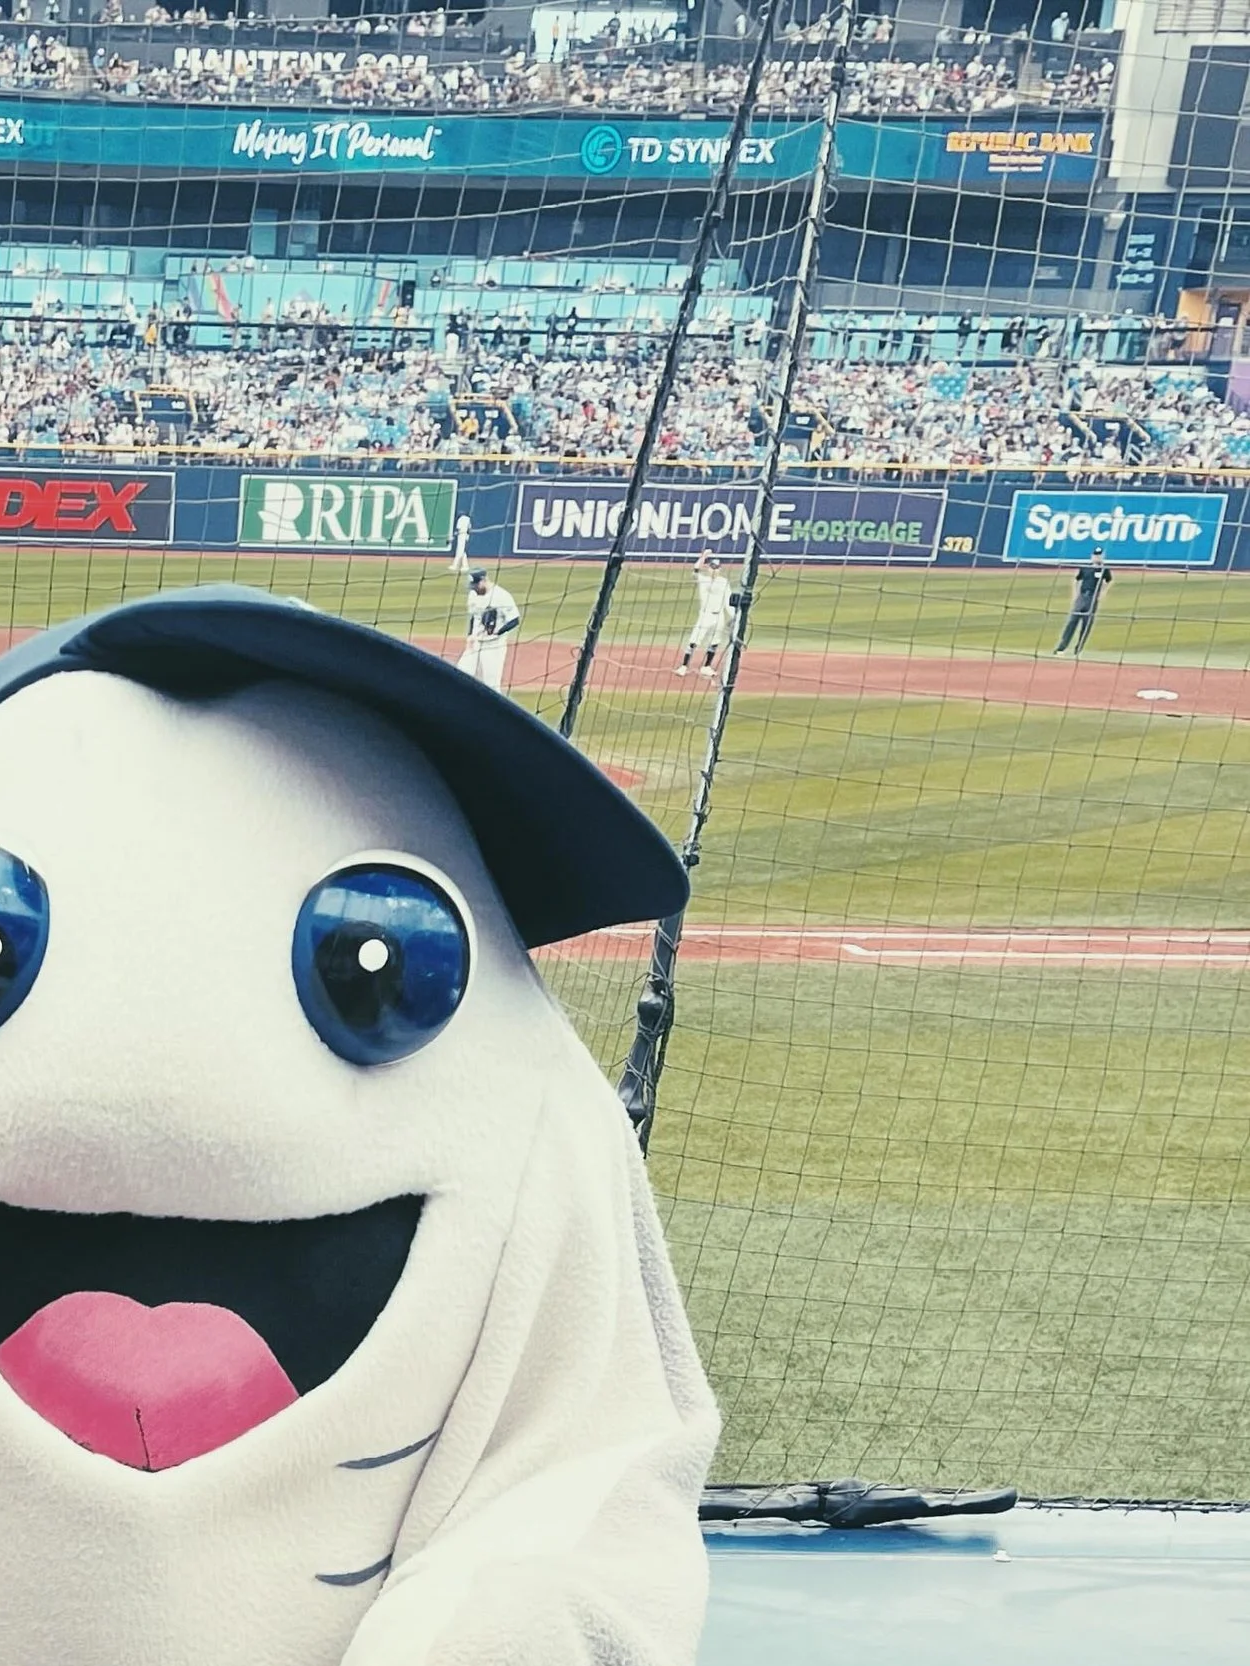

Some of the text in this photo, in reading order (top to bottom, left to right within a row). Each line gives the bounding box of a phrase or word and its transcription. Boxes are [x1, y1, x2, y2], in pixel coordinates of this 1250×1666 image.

[233, 119, 435, 165] Making IT Personal
[627, 136, 663, 163] TD
[305, 484, 435, 544] RIPA
[1025, 504, 1201, 550] Spectrum
[792, 520, 923, 545] MORTGAGE
[942, 536, 974, 553] 378
